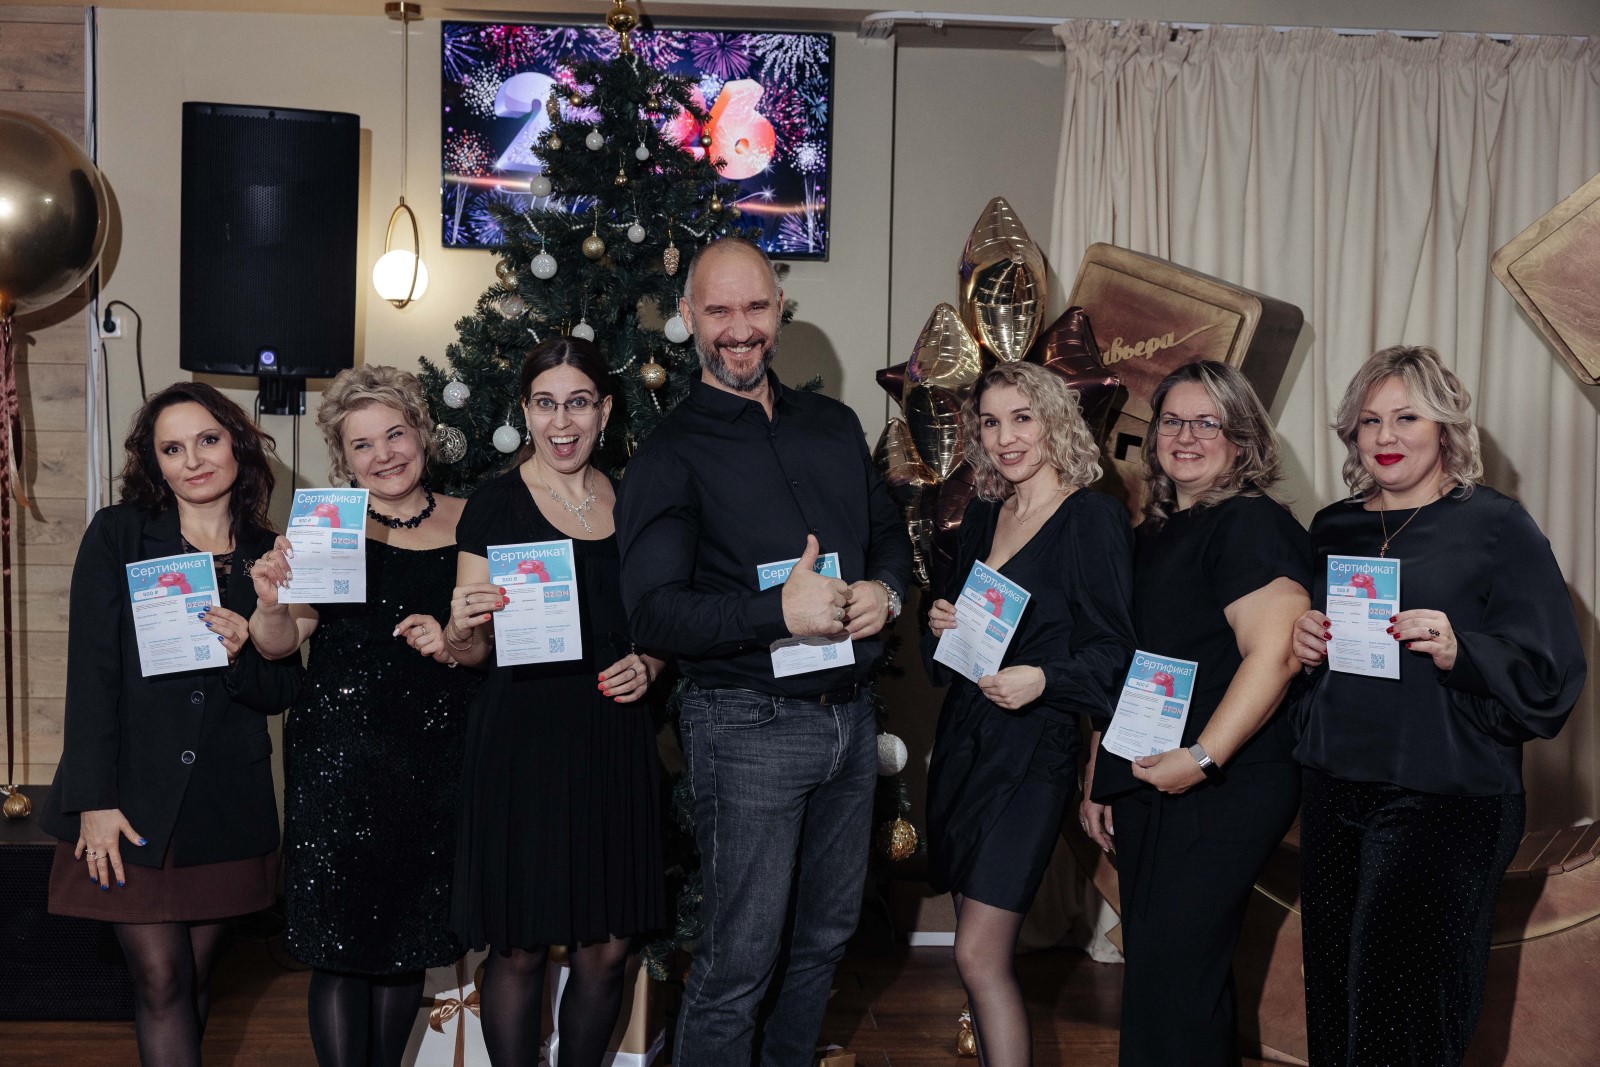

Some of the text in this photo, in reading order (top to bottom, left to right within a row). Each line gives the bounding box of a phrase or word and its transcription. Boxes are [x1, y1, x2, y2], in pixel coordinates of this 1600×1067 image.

[297, 493, 363, 505] Сертификат
[491, 547, 566, 563] Сертификат
[130, 559, 207, 578] Сертификат
[762, 560, 833, 579] Серткат
[1330, 561, 1395, 574] Сертификат
[974, 567, 1025, 604] Сертификат
[1135, 656, 1193, 677] Сертификат
